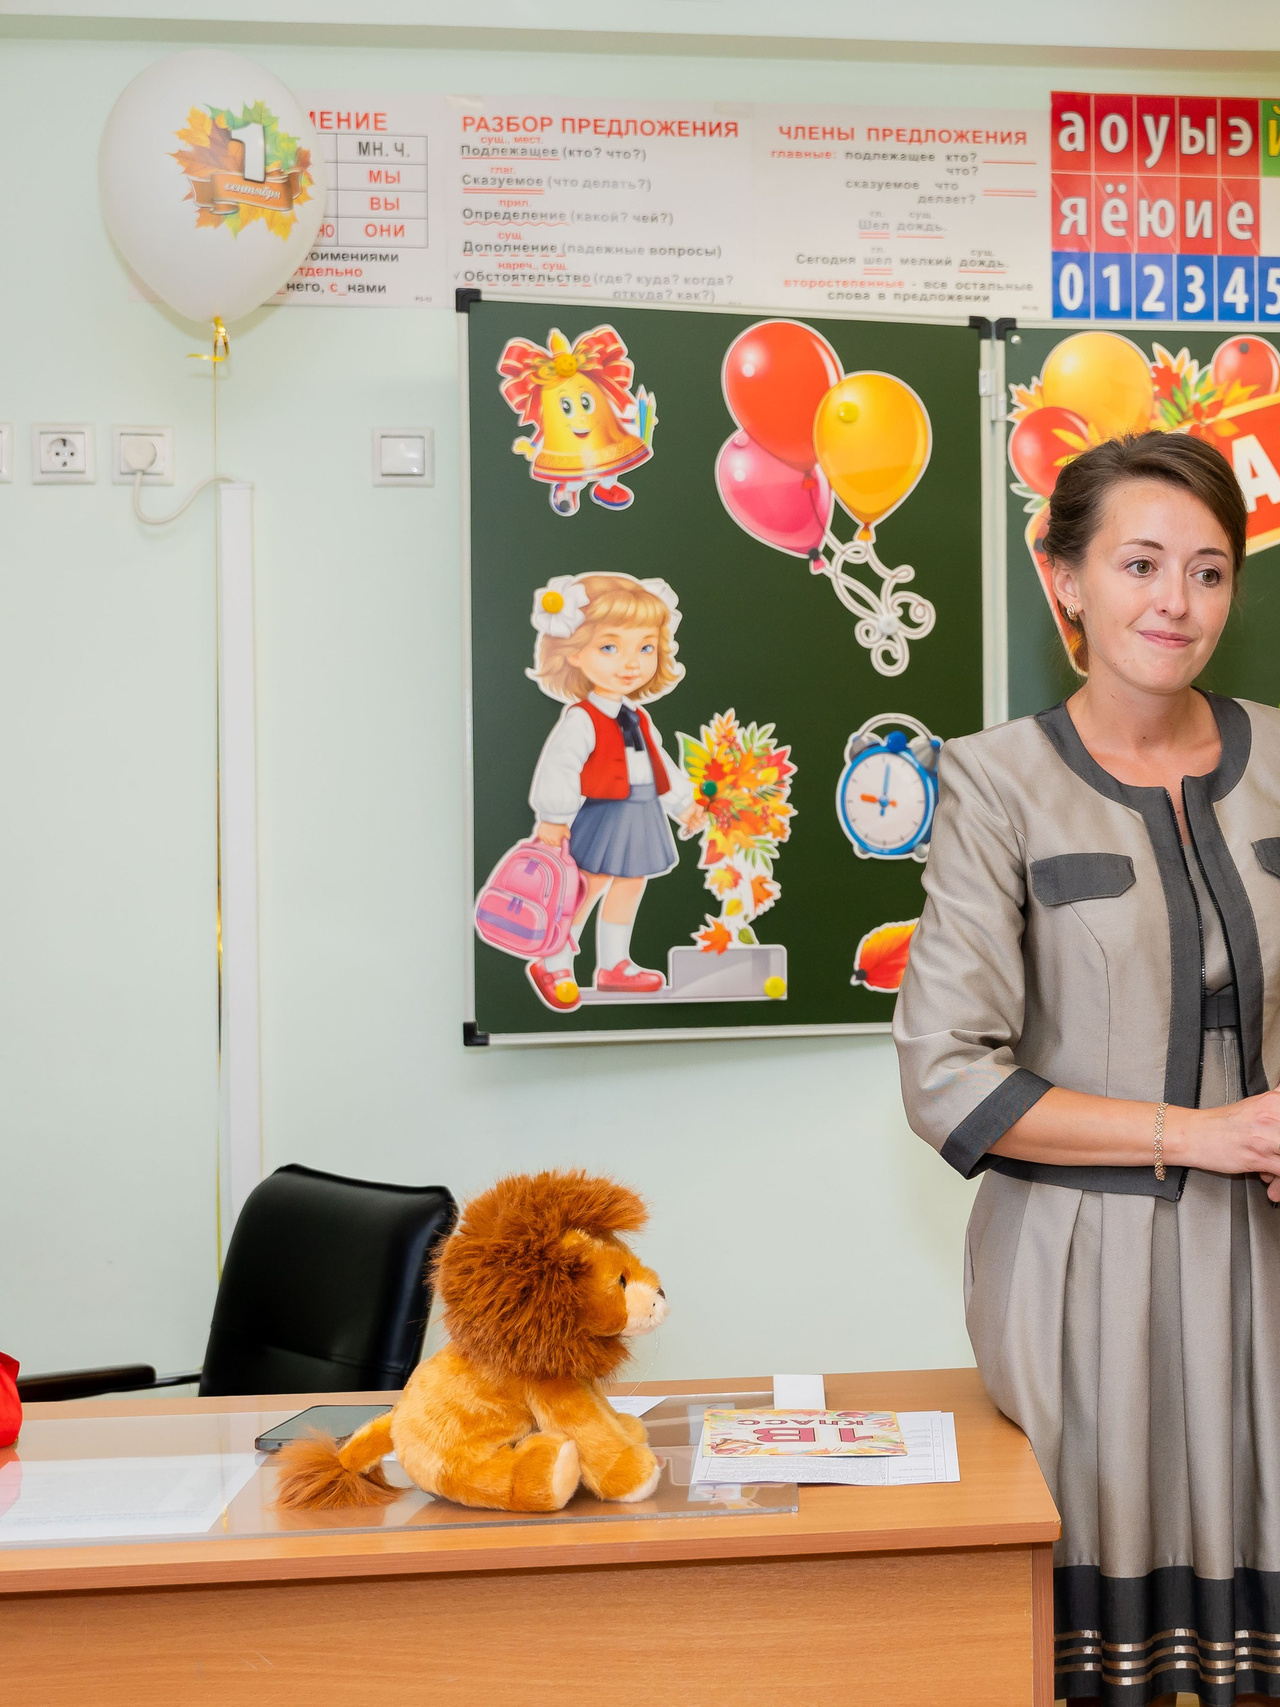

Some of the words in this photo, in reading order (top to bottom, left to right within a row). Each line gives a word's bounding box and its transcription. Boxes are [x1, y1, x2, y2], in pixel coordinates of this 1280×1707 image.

[462, 116, 554, 133] РАЗБОР
[561, 117, 739, 138] ПРЕДЛОЖЕНИЯ
[779, 126, 855, 141] ЧЛЕНЫ
[867, 127, 1028, 145] ПРЕДЛОЖЕНИЯ
[231, 122, 266, 184] 1
[461, 145, 559, 158] Подлежащее
[563, 147, 602, 160] (кто?
[606, 148, 647, 162] что?)
[845, 151, 936, 163] подлежащее
[945, 152, 977, 163] кто?
[368, 170, 401, 185] МЫ
[945, 166, 979, 176] что?
[462, 174, 544, 188] Сказуемое
[845, 180, 920, 191] сказуемое
[934, 182, 959, 191] что
[224, 183, 281, 201] сентября
[370, 197, 400, 212] ВЫ
[918, 195, 976, 205] делает?
[463, 208, 566, 221] Определение
[633, 212, 674, 226] чей?)
[365, 223, 405, 238] ОНИ
[463, 241, 558, 254] Дополнение
[650, 245, 722, 259] вопросы)
[796, 253, 857, 265] Сегодня
[900, 256, 953, 267] мелкий
[464, 270, 591, 283] Обстоятельство
[637, 274, 680, 287] куда?
[684, 275, 735, 287] когда?
[783, 279, 905, 290] второстепенные
[924, 281, 948, 290] все
[955, 281, 1034, 292] остальные
[1058, 262, 1085, 311] 0
[1102, 263, 1121, 311] 1
[1142, 264, 1165, 312] 2
[1183, 265, 1206, 313] 3
[1223, 266, 1249, 314] 4
[827, 291, 871, 301] слова
[878, 292, 886, 301] в
[893, 292, 991, 303] предложении
[737, 1418, 864, 1427] КЛАСС
